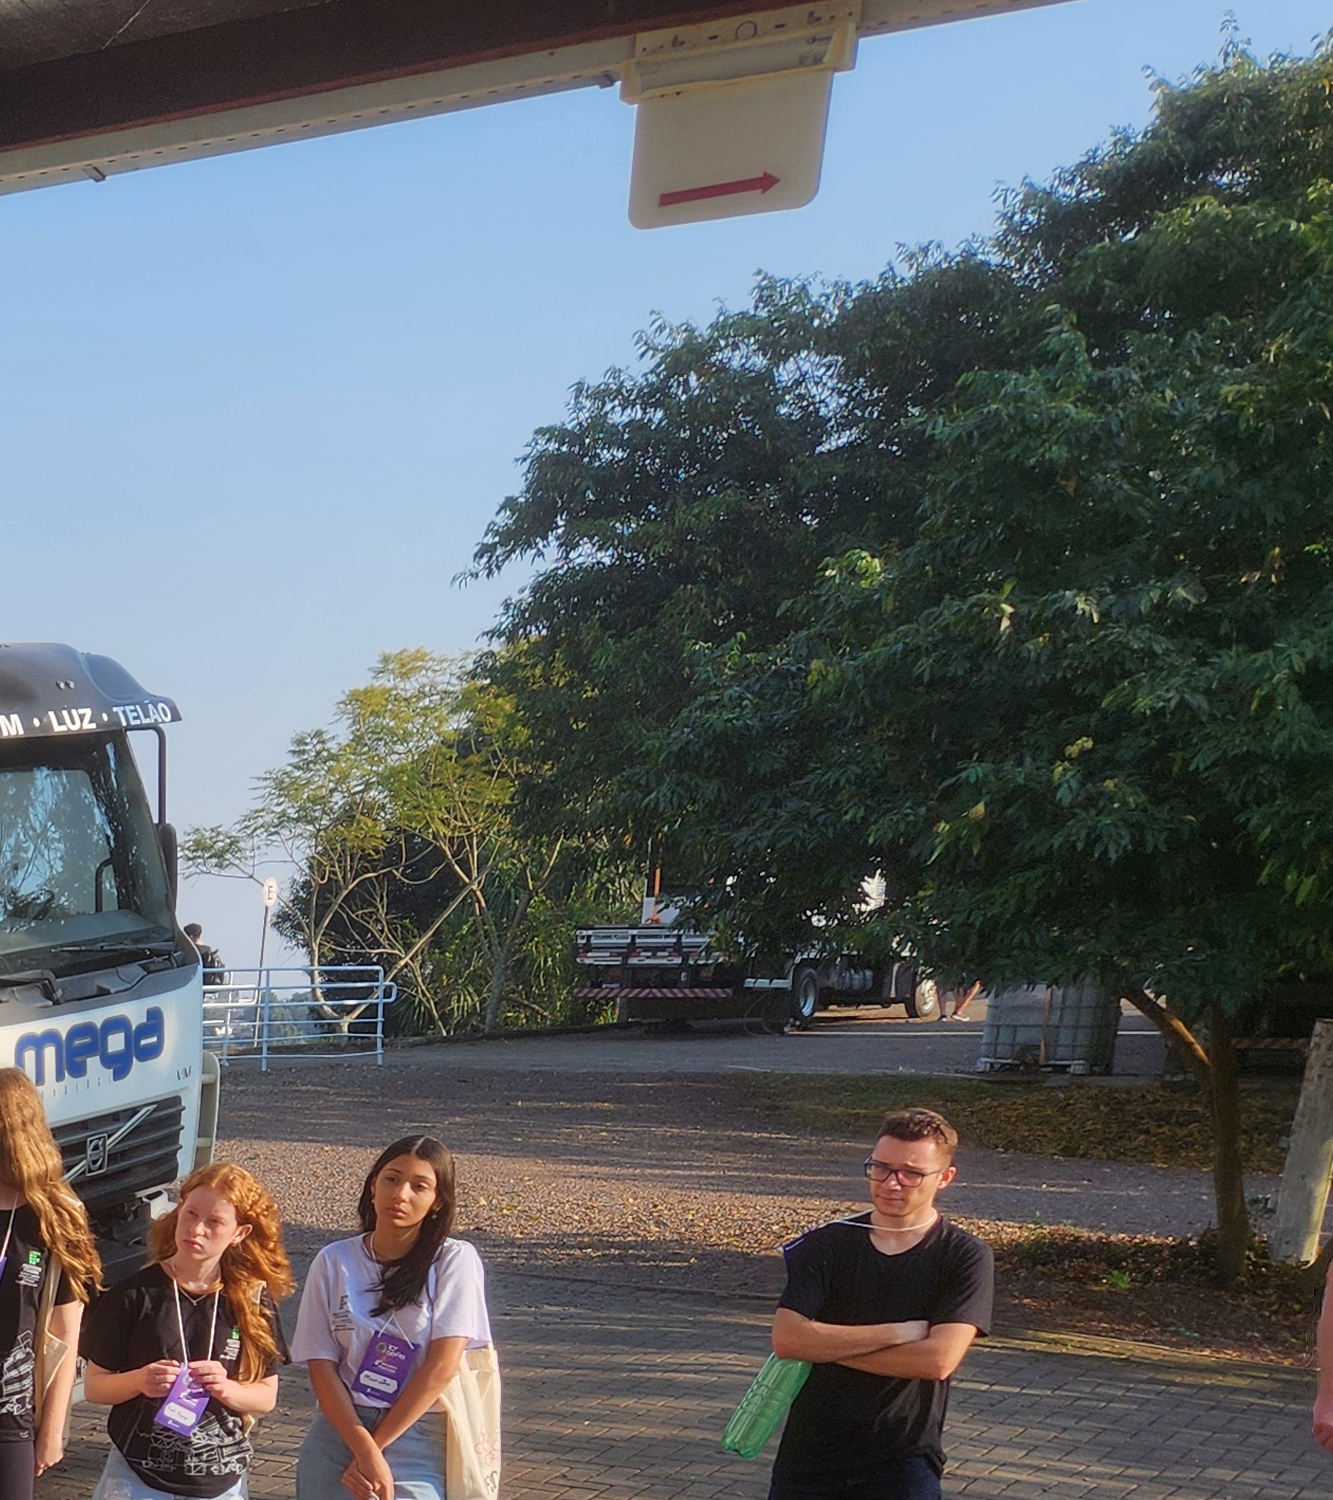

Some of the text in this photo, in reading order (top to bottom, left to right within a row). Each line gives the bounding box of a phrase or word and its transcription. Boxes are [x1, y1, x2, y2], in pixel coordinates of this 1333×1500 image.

[48, 708, 97, 732] LUZ
[112, 700, 171, 727] TELÃO
[15, 1006, 165, 1086] mega
